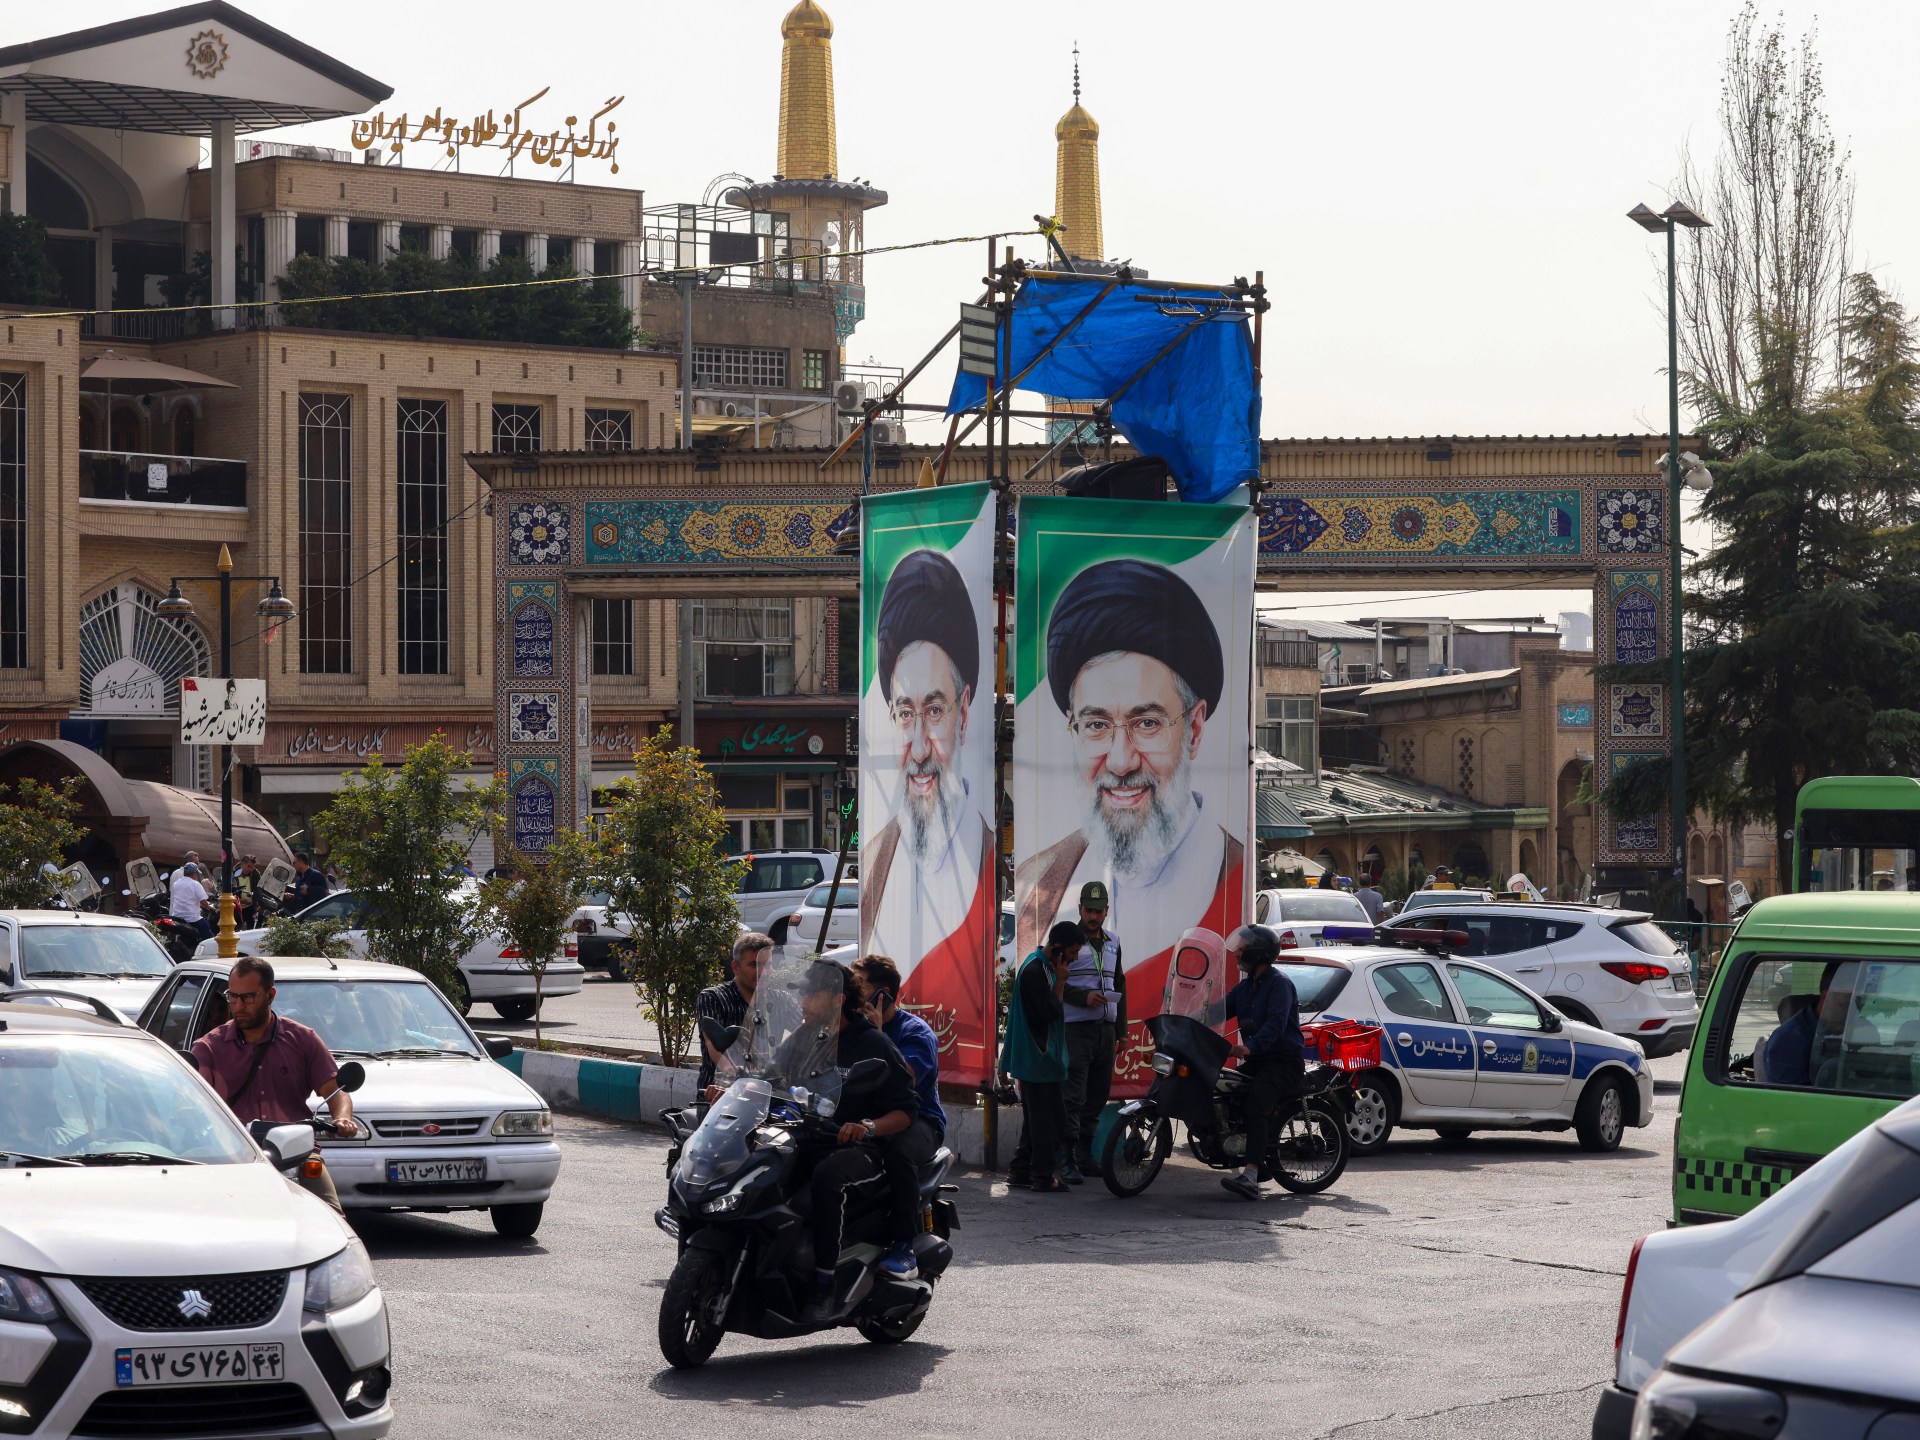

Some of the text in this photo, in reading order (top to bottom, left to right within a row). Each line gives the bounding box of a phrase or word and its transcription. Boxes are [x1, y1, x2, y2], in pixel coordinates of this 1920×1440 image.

[352, 112, 407, 152] ایران
[411, 107, 457, 157] جواهر
[472, 109, 498, 147] طلا
[499, 86, 550, 160] مرکز
[118, 667, 140, 708] بزرگ
[139, 682, 154, 708] بازار
[182, 698, 208, 741] شهید
[322, 735, 356, 752] ساعت
[357, 728, 388, 757] گالری
[742, 723, 786, 750] مهدی
[780, 727, 808, 752] سید
[1413, 1037, 1467, 1062] پلیس
[252, 1353, 281, 1378] ۴۴
